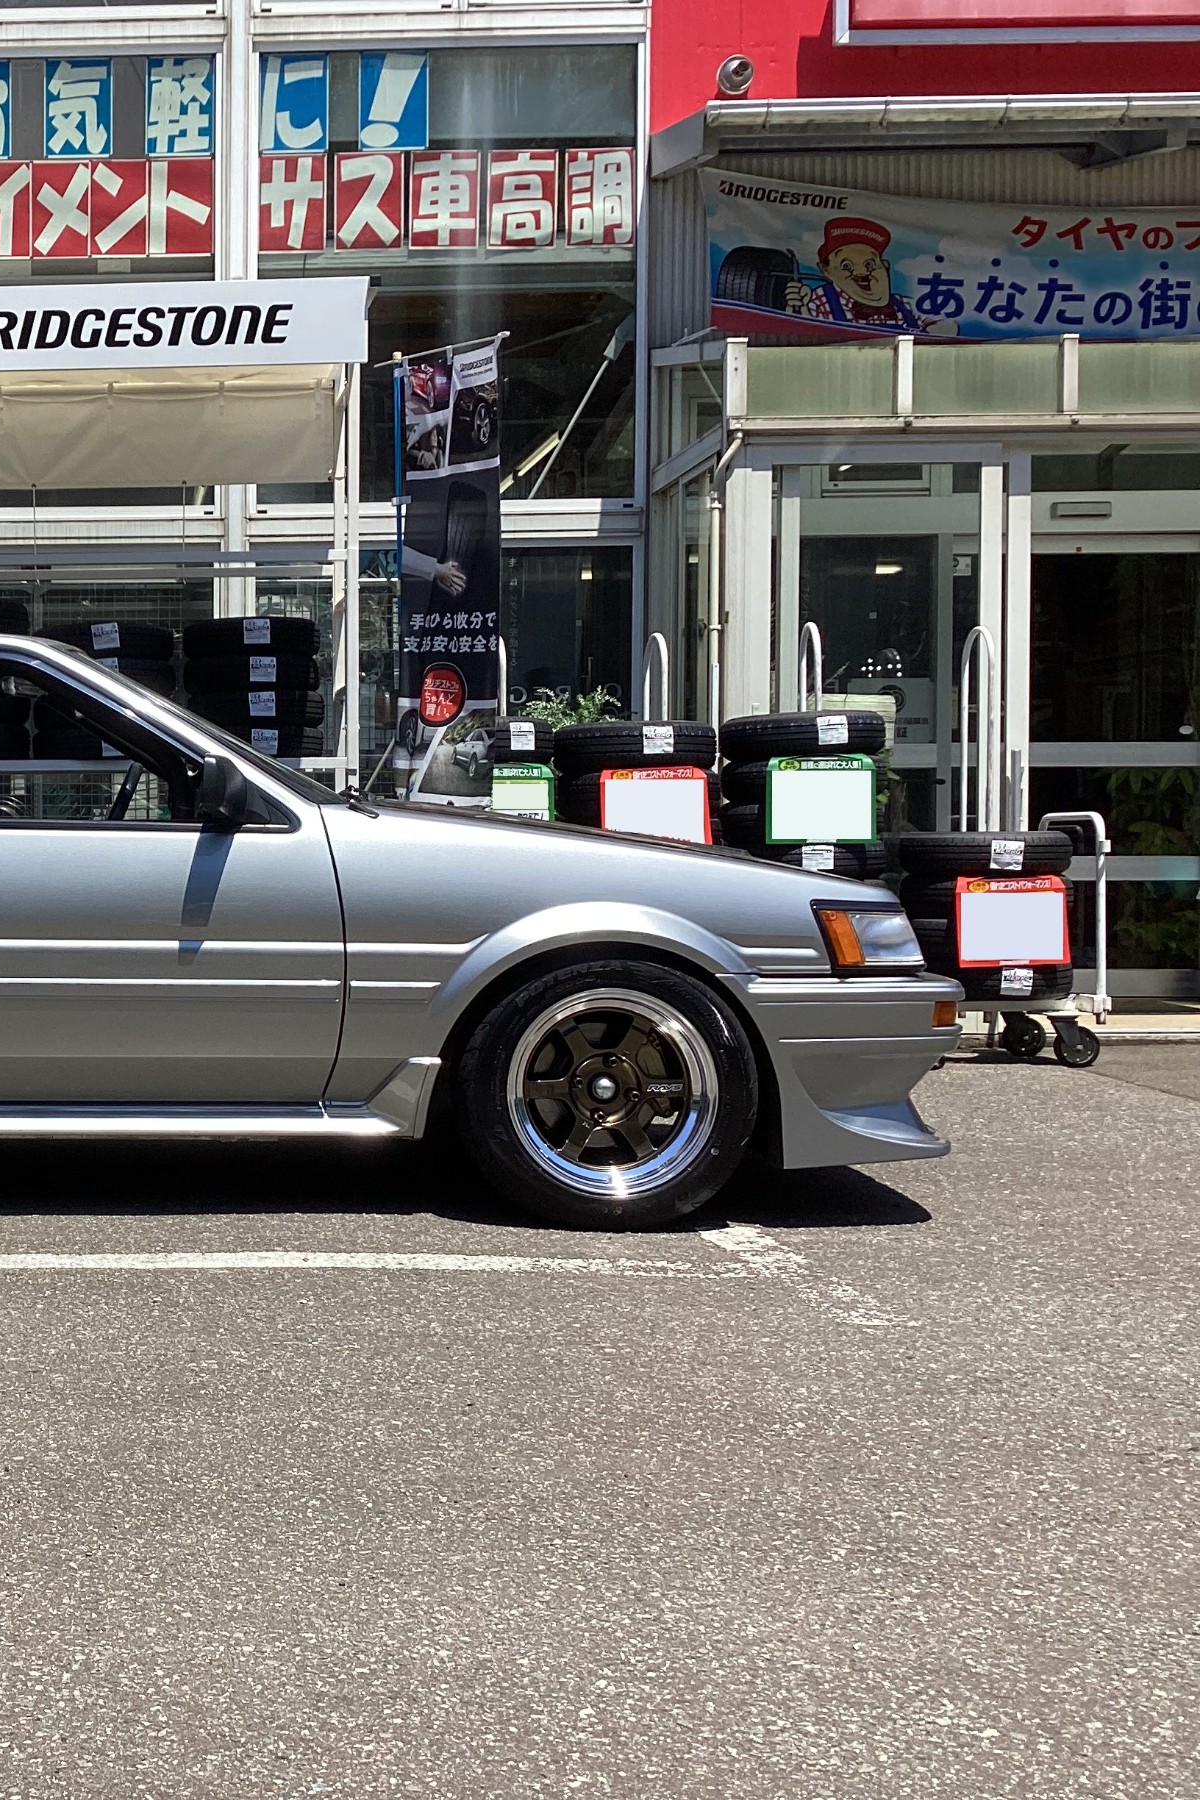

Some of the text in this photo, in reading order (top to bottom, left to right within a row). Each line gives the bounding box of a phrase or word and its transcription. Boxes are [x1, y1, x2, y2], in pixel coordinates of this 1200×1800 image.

[261, 150, 632, 249] サス車高調
[719, 181, 848, 210] BRIDGESTONE
[916, 273, 1200, 330] あなたの街
[424, 691, 455, 705] ちゃんと
[647, 1083, 683, 1093] RAYS
